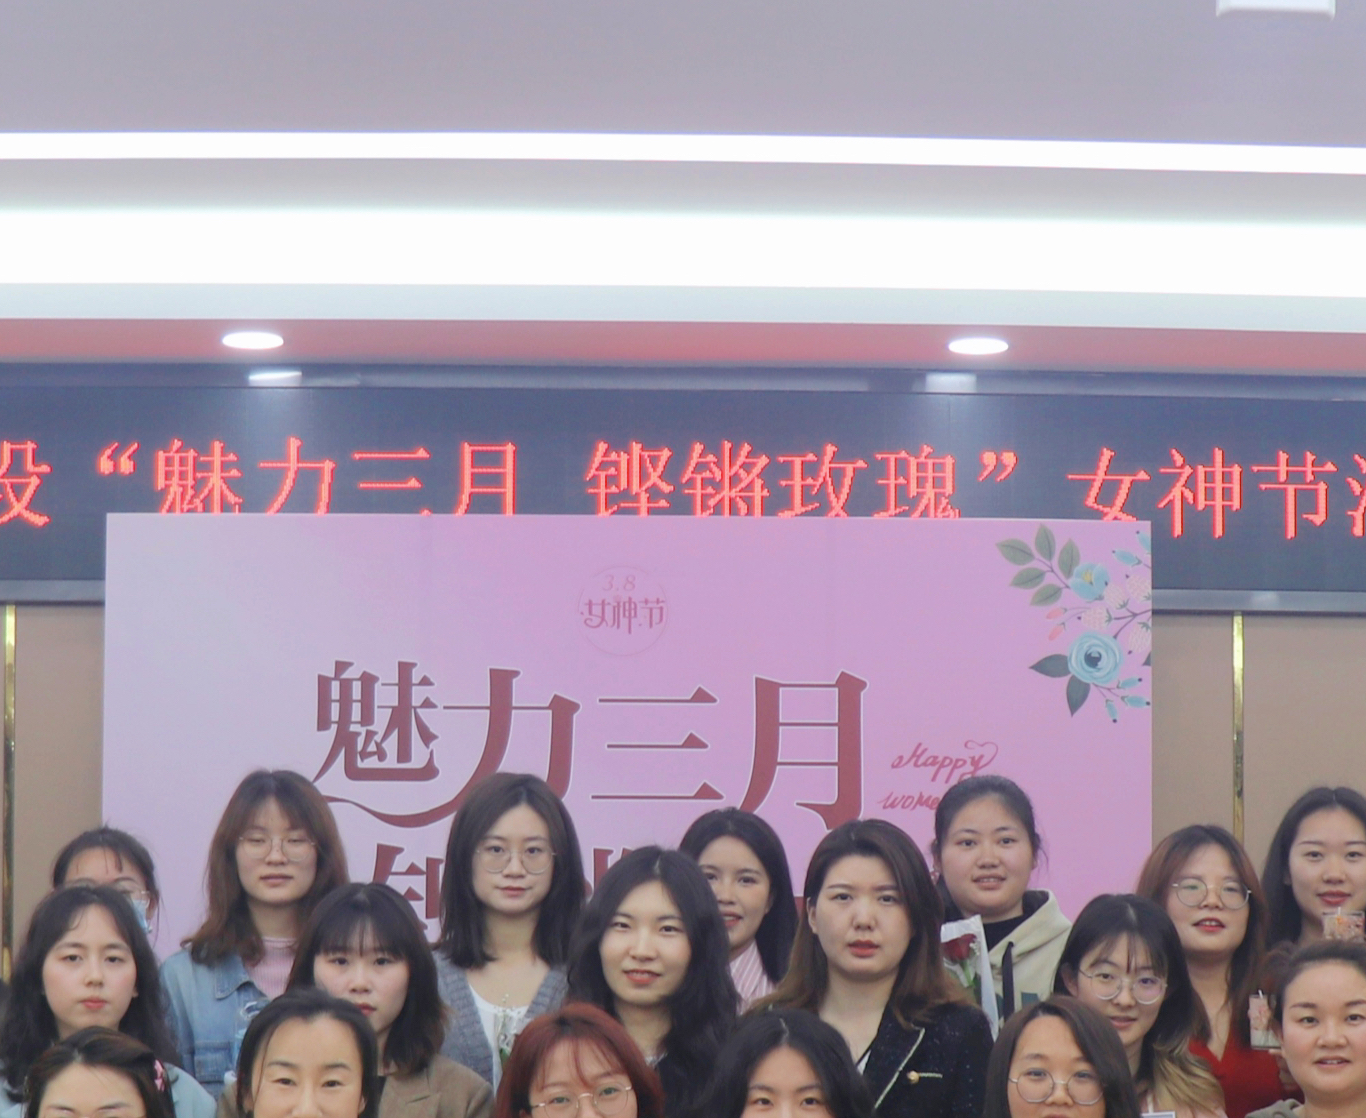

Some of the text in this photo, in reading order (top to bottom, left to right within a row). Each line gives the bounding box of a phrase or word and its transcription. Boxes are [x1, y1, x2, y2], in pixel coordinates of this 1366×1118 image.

[601, 573, 637, 592] 3.8
[579, 595, 666, 636] 女神节
[311, 660, 867, 830] 魅力三月
[890, 739, 999, 784] Happy
[876, 791, 940, 812] wome
